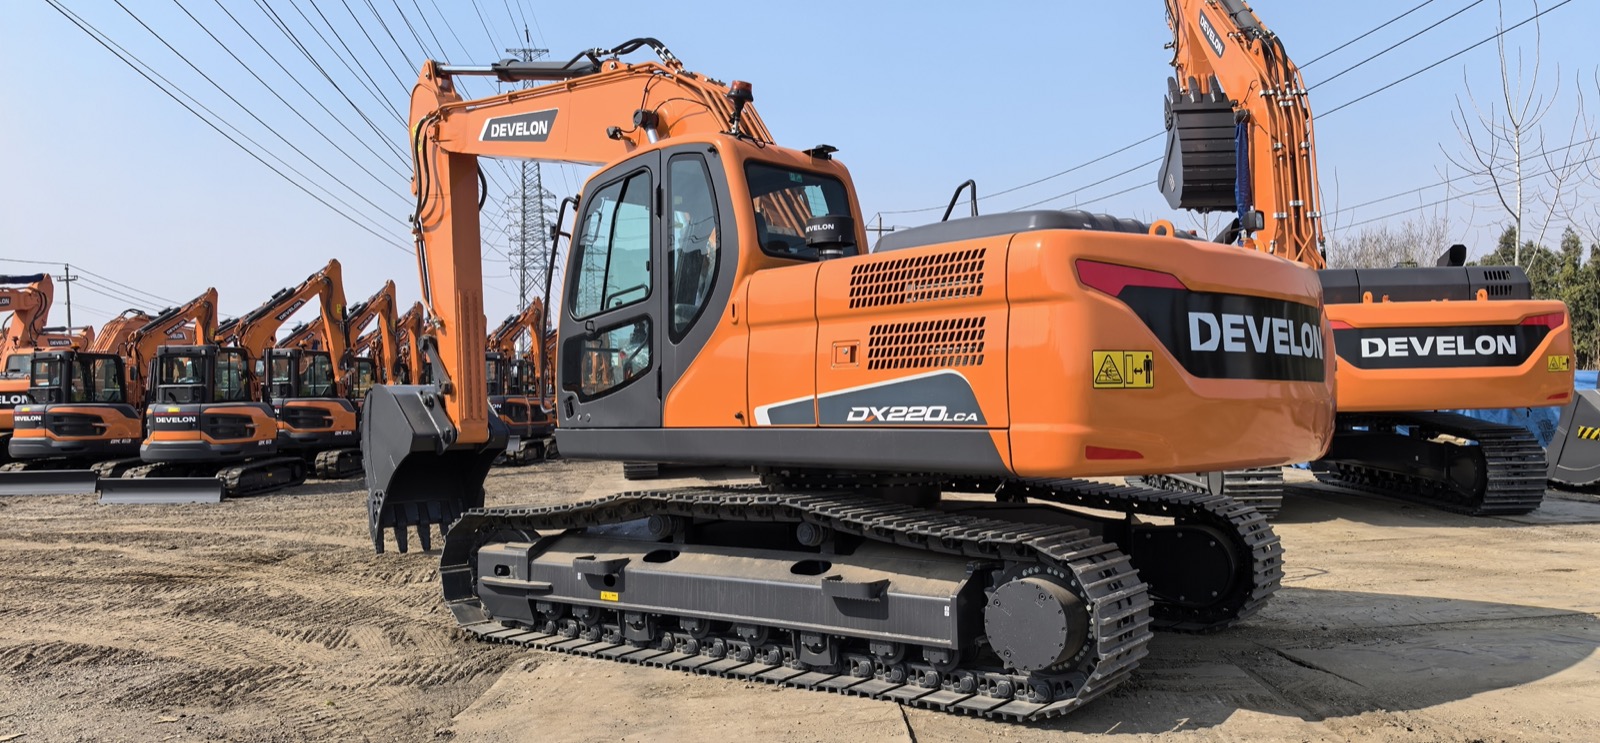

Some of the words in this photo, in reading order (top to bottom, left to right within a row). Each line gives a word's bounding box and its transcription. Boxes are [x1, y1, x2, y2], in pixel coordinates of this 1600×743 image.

[1200, 15, 1223, 55] DEVELON
[491, 120, 548, 137] DEVELON
[1187, 311, 1324, 359] DEVELON
[1361, 335, 1517, 358] DEVELON
[155, 416, 196, 424] DEVELON
